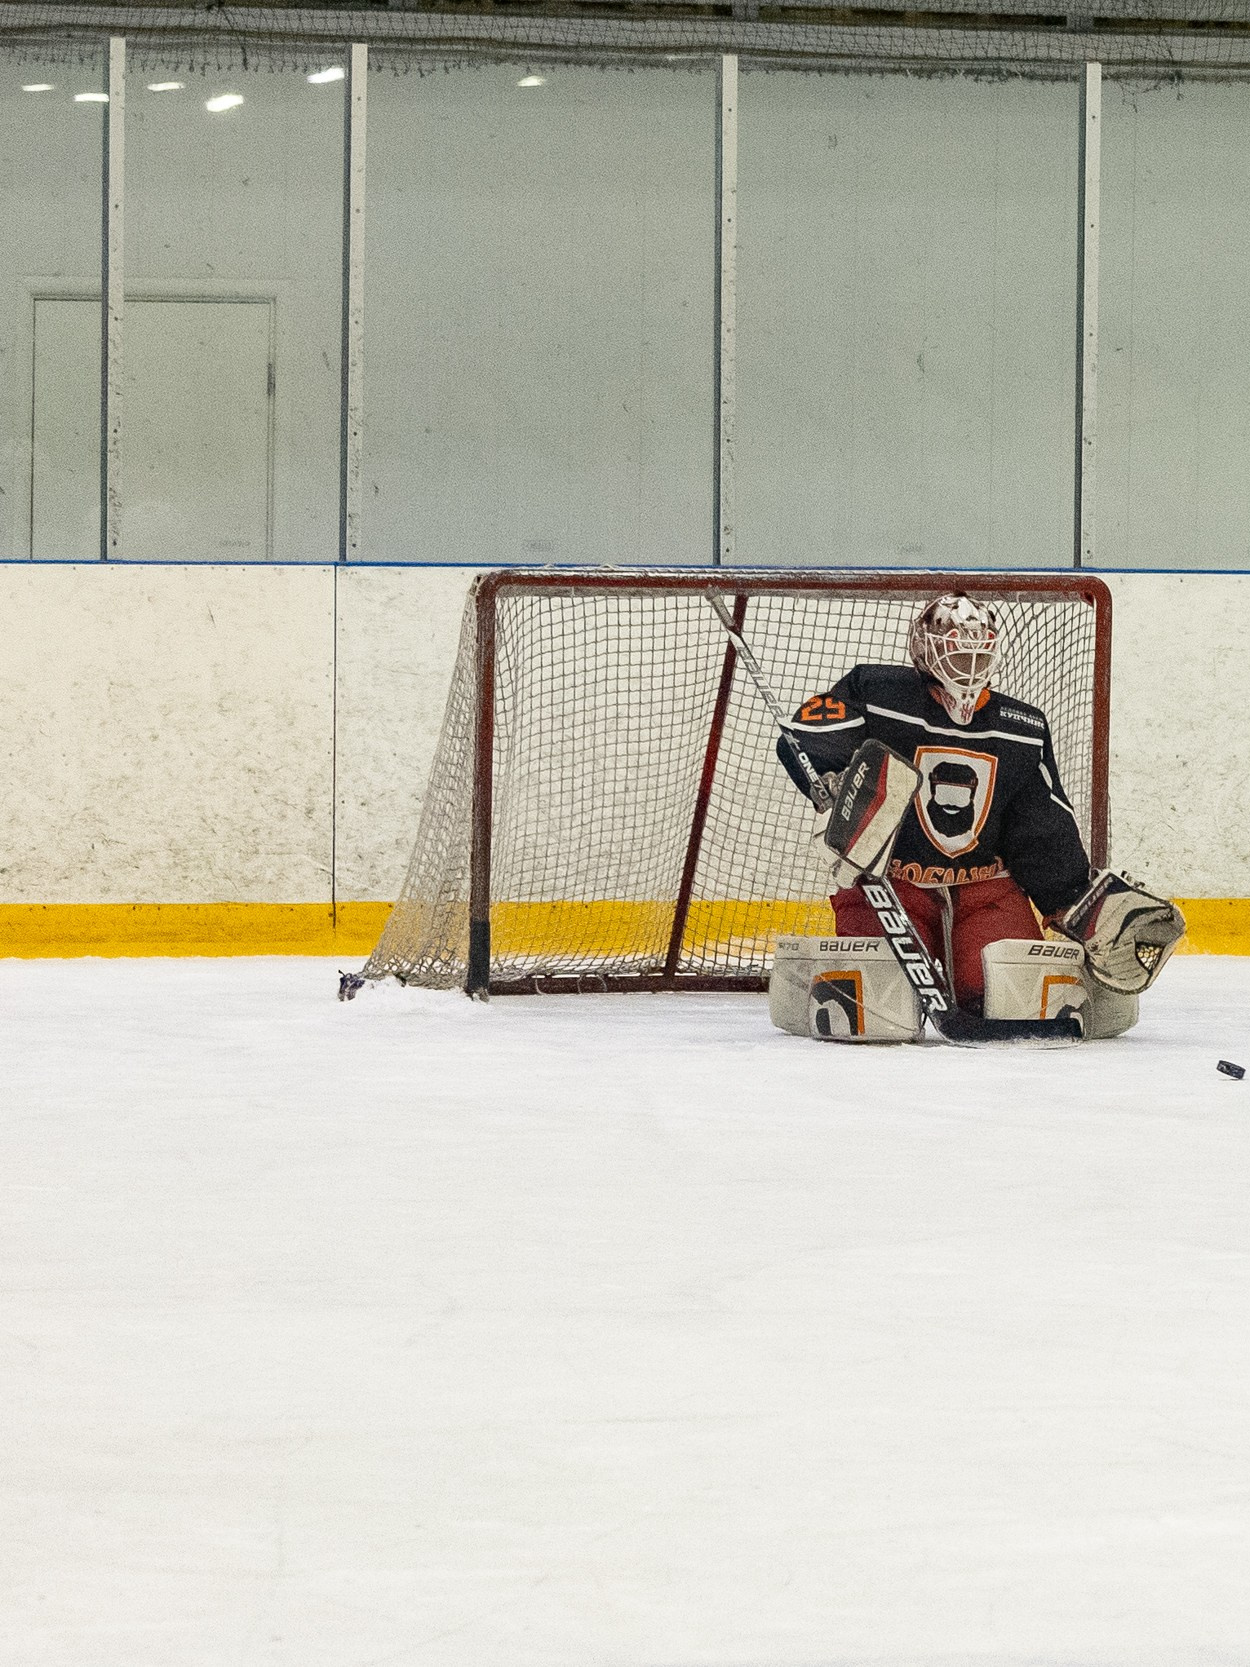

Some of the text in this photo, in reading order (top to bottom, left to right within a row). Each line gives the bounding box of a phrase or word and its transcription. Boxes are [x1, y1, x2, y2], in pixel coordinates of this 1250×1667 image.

[841, 761, 871, 822] BAUER
[819, 940, 880, 952] BAUER
[862, 884, 948, 1013] BAUER
[1028, 944, 1080, 960] BAUER
